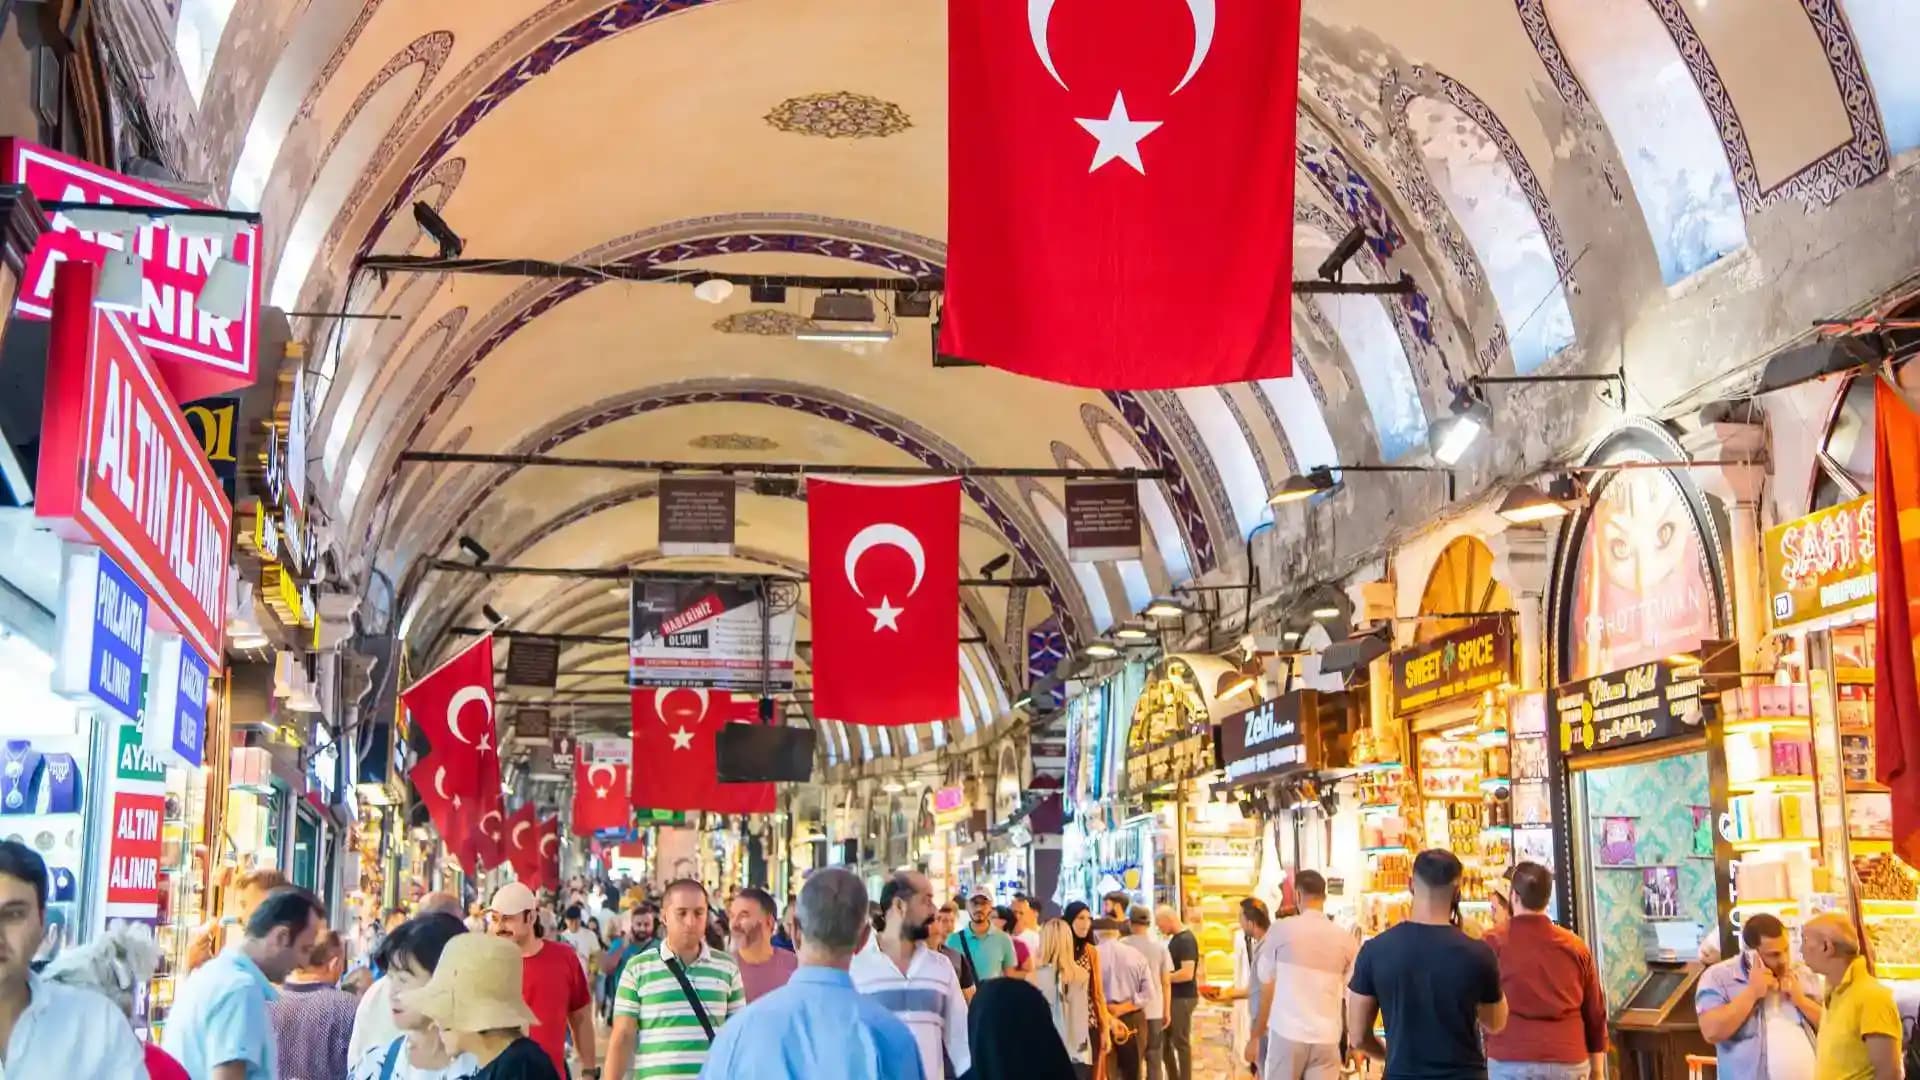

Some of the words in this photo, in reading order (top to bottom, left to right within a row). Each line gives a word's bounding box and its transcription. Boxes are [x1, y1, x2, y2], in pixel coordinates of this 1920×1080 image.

[34, 248, 233, 352] ANIR
[97, 358, 172, 557] ALTIN
[169, 468, 222, 631] ALINIR
[97, 570, 143, 656] PIRLANTA
[668, 633, 702, 646] OLSUN!
[1405, 650, 1442, 689] SWEET
[1457, 633, 1495, 672] SPICE
[100, 650, 131, 705] ALINIR
[1244, 702, 1274, 748] Zeki
[553, 754, 574, 764] WC
[117, 807, 159, 841] ALTIN
[110, 855, 158, 890] ALINIR
